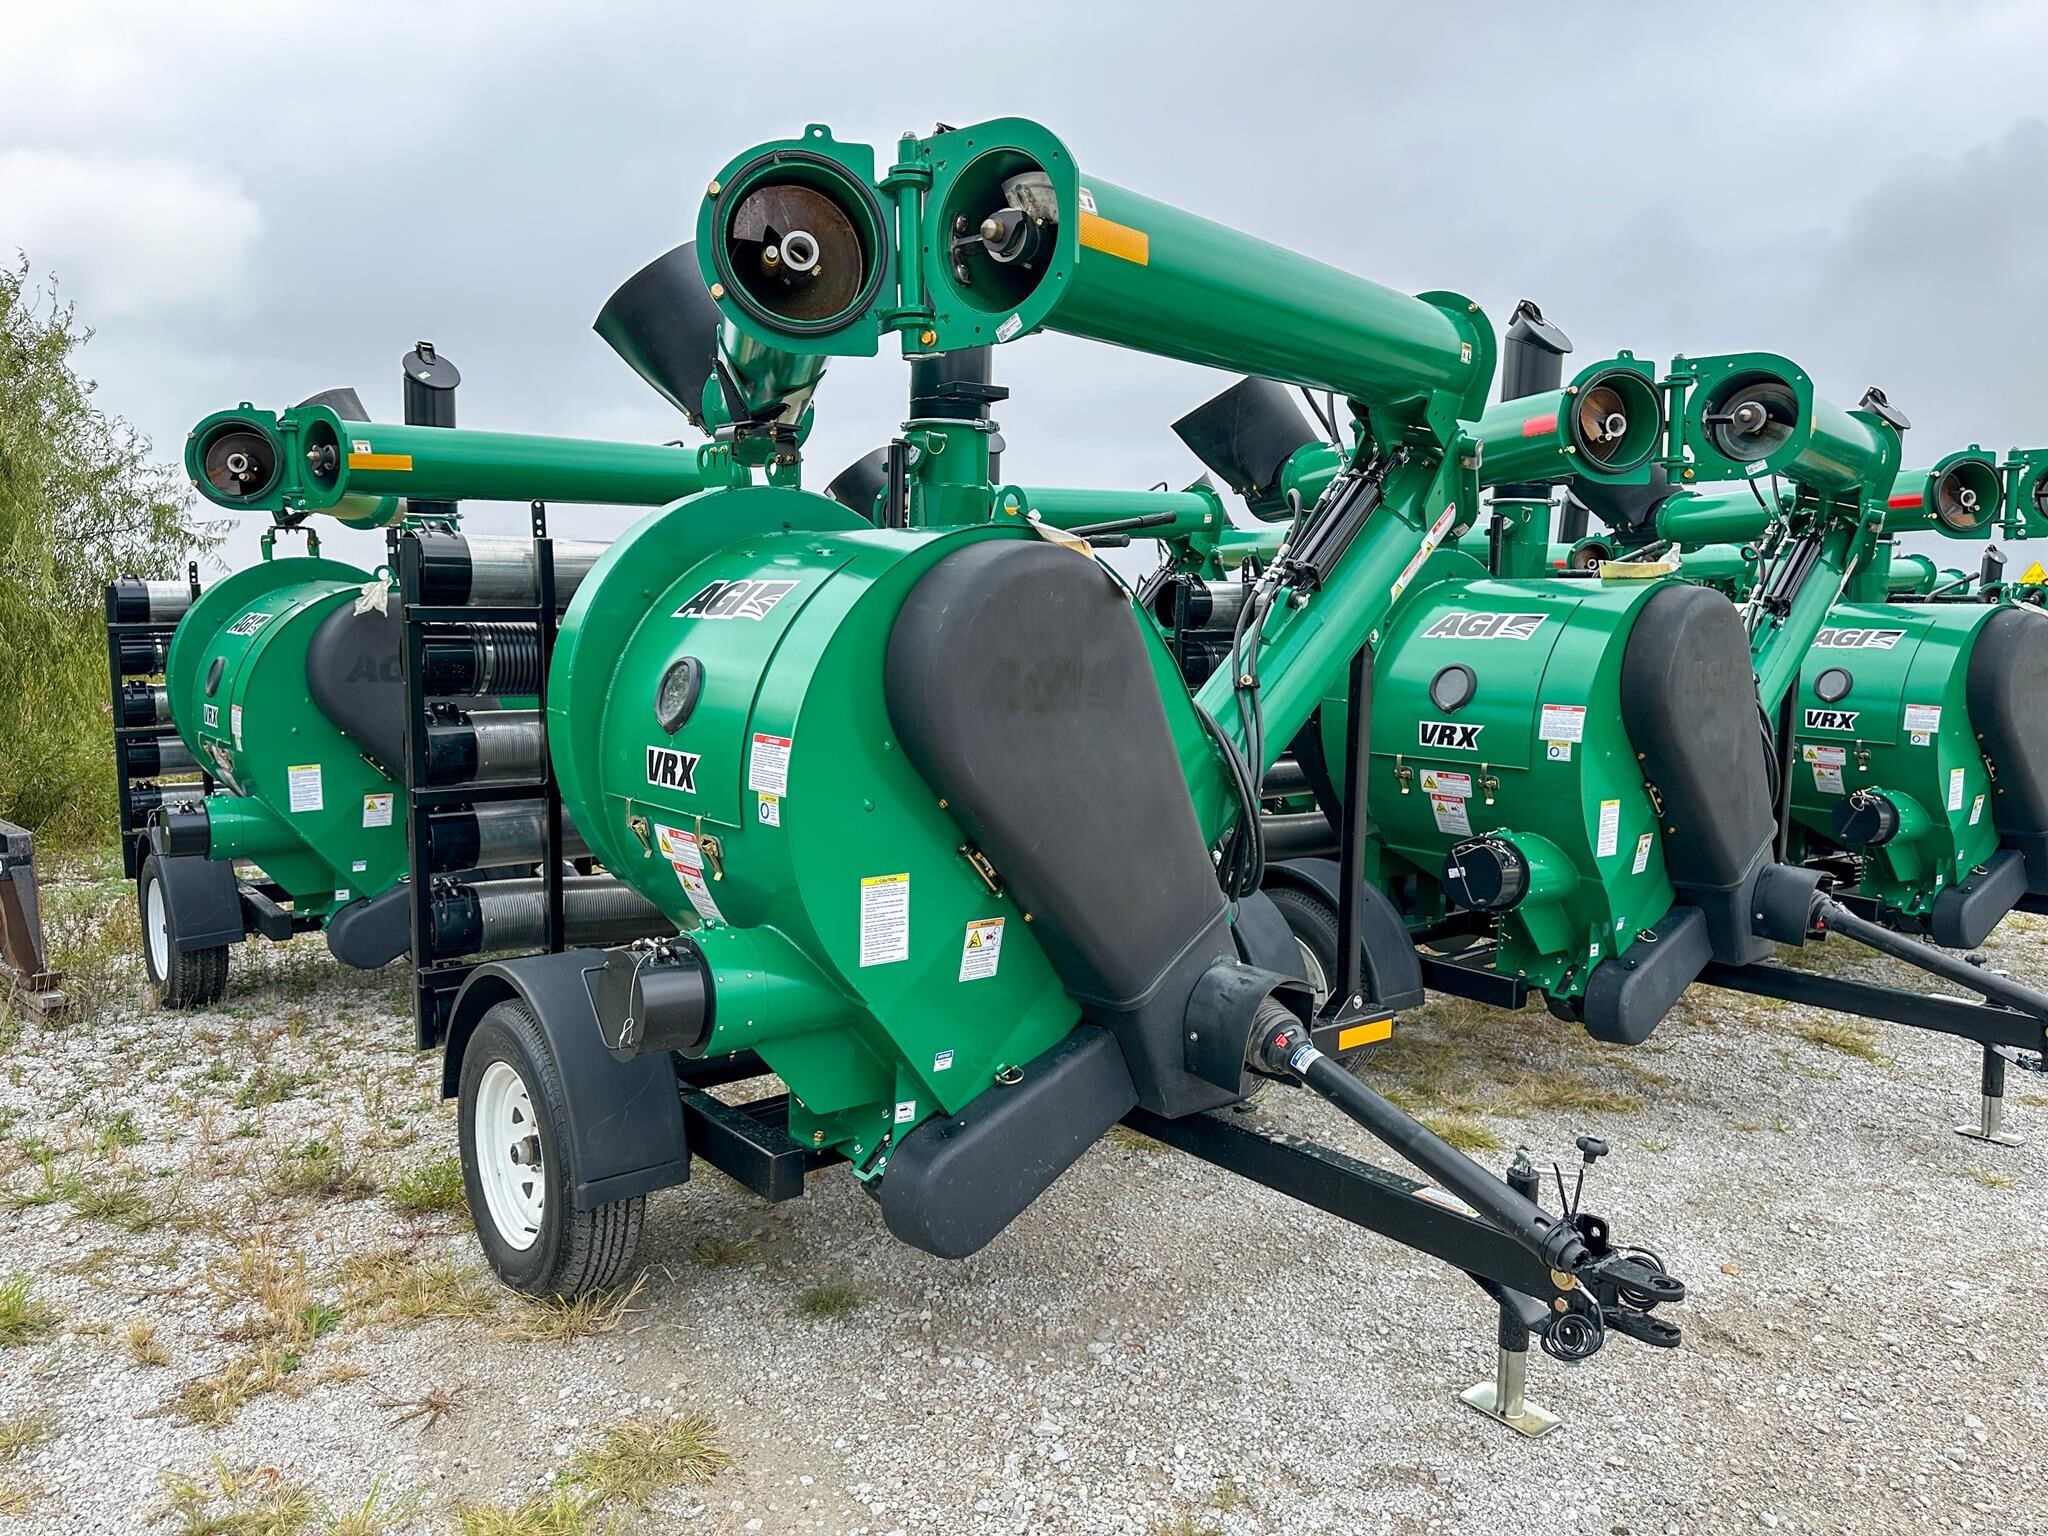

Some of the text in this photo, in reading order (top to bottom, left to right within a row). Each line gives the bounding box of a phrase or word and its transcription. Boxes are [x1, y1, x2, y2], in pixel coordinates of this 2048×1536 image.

[677, 582, 764, 616] AGI
[229, 613, 262, 633] AGI
[1426, 615, 1510, 637] AGI
[1813, 630, 1874, 646] AGI
[346, 656, 401, 683] AG
[203, 705, 218, 726] VRX
[1805, 710, 1856, 729] VRX
[1421, 723, 1480, 748] VRX
[648, 749, 697, 790] VRX
